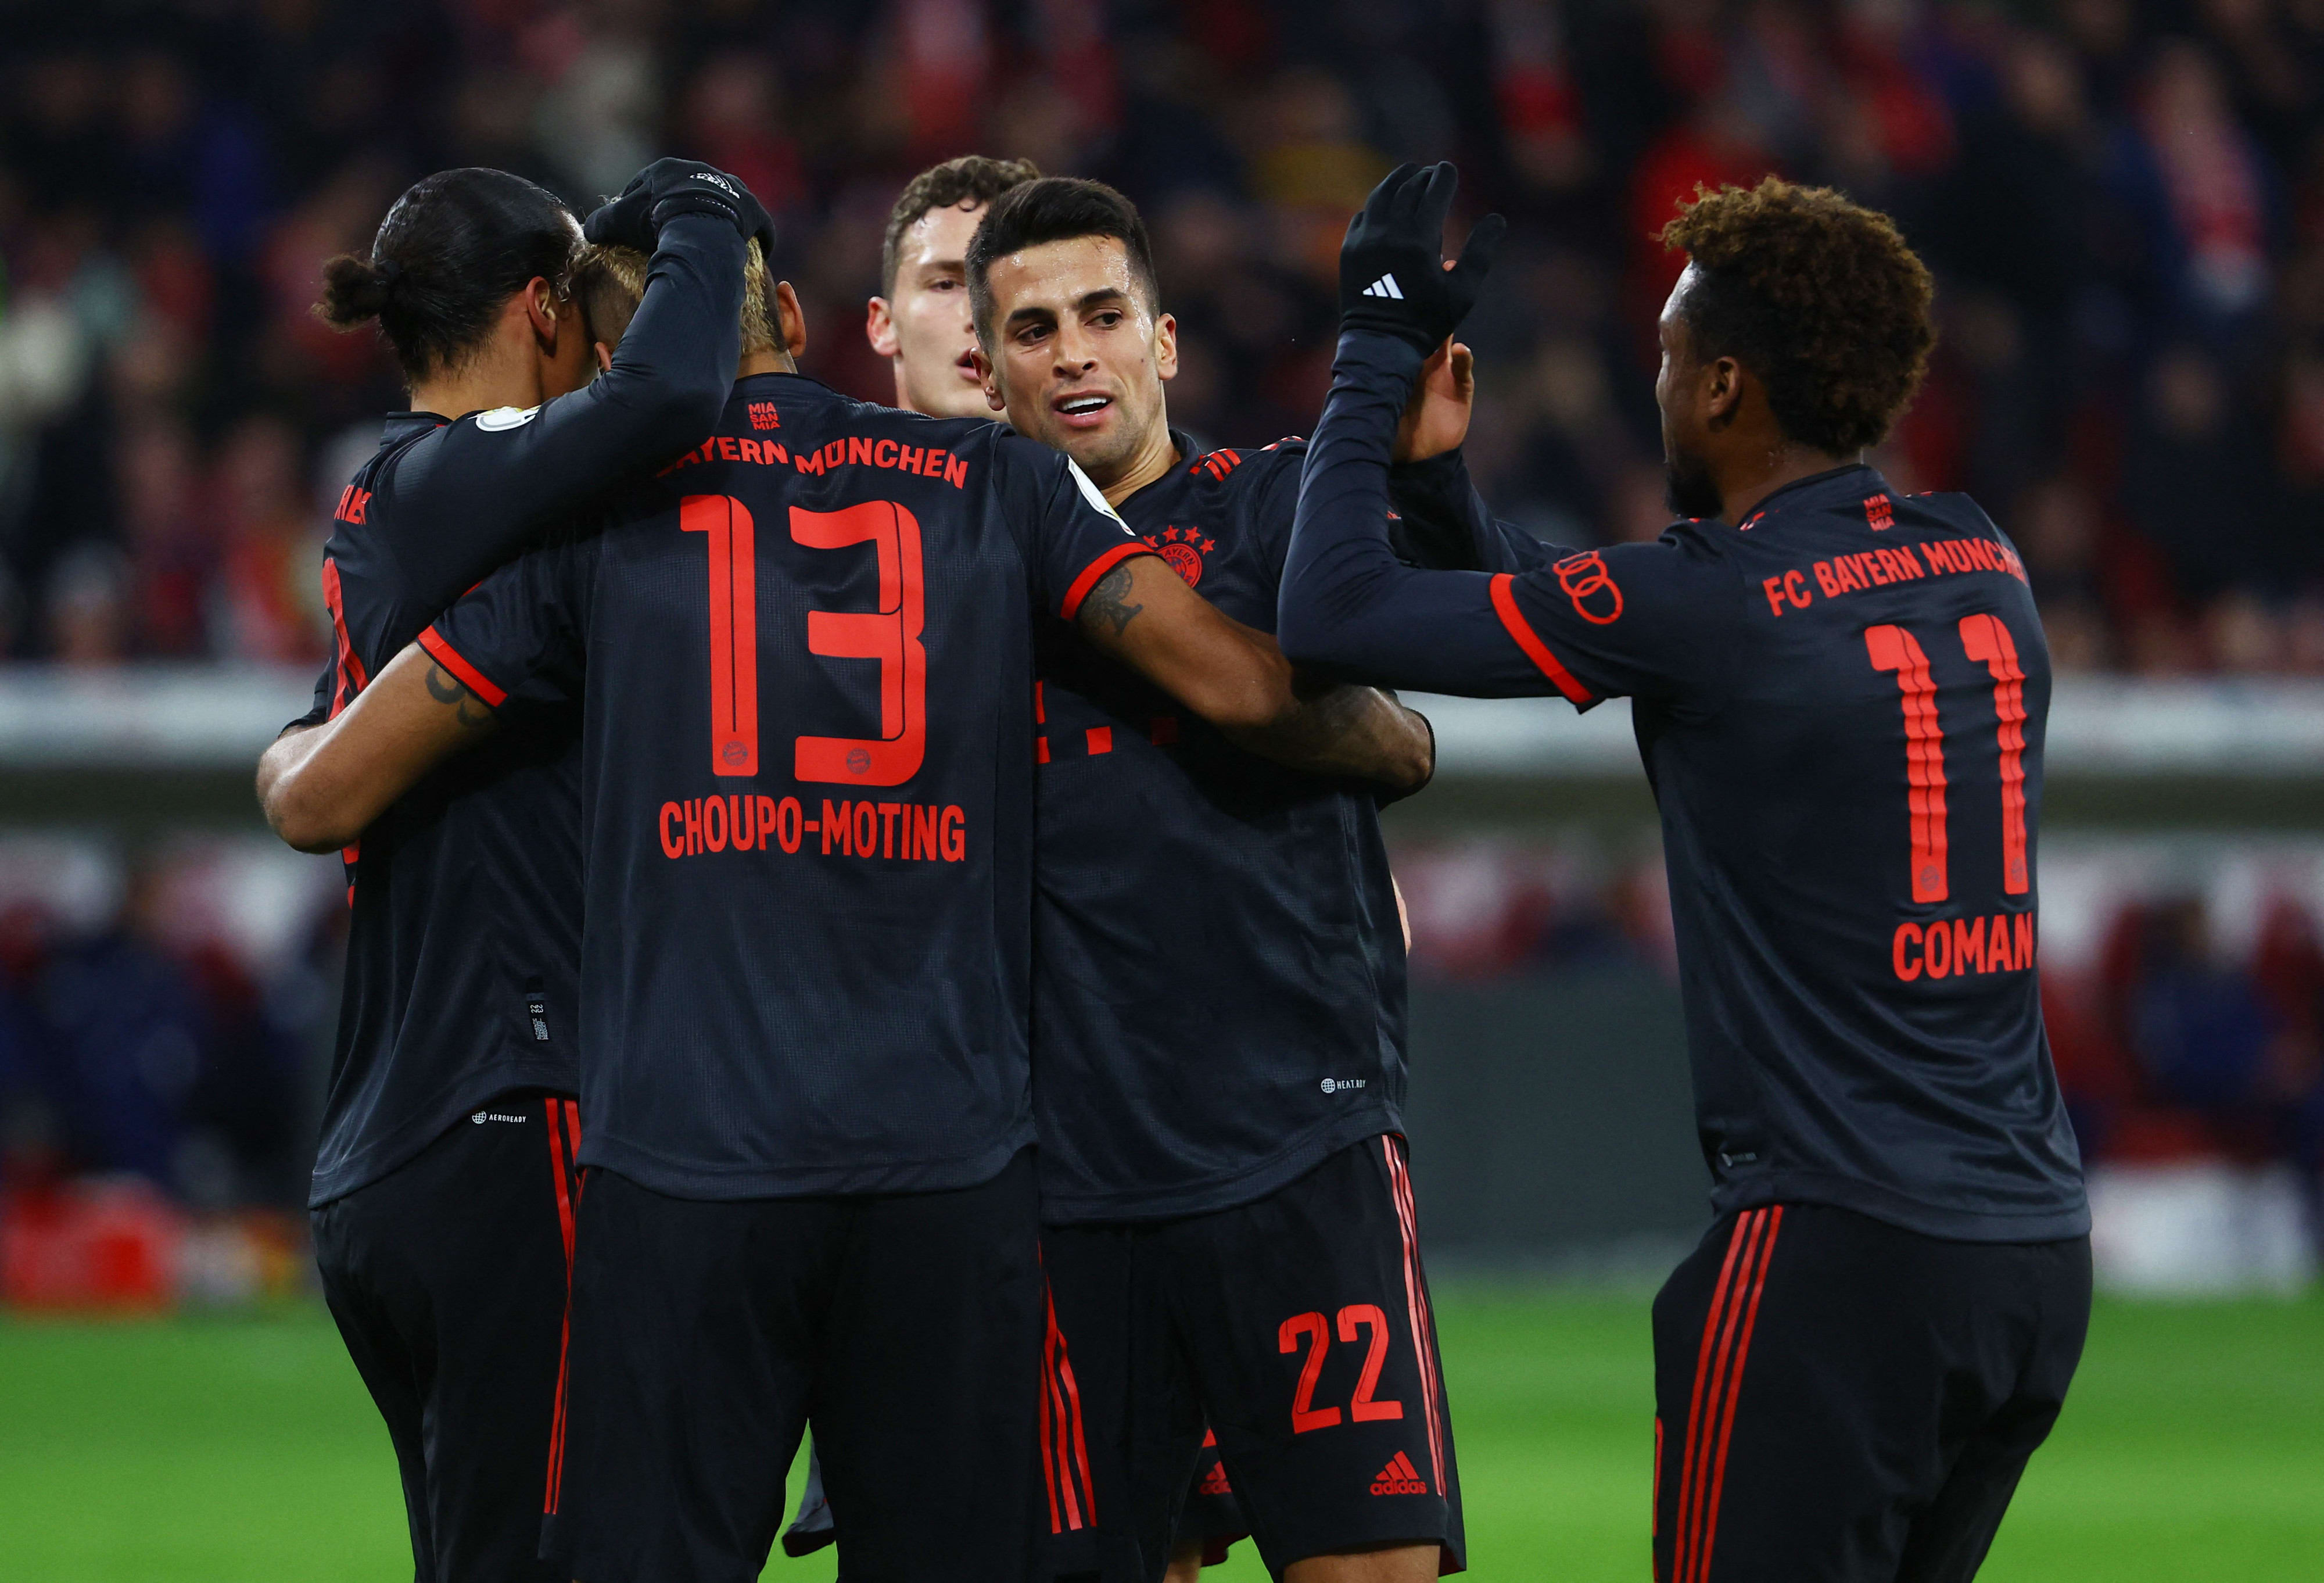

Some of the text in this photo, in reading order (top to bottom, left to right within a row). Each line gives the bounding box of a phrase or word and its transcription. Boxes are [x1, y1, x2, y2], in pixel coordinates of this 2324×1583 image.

[748, 402, 777, 414] MIA
[749, 413, 780, 422] SAN
[753, 421, 781, 431] MIA
[655, 436, 969, 489] AYERN MÜNCHEN
[1163, 547, 1196, 565] AYERN
[1762, 569, 1812, 617] FC
[1812, 543, 1926, 599] BAYERN
[680, 494, 927, 787] 13
[1864, 613, 2029, 904] 11
[659, 794, 966, 862] CHOUPO-MOTING
[1892, 912, 2033, 982] COMAN
[1337, 1079, 1366, 1090] HEAT.RDY
[489, 1114, 526, 1123] AEROREADY
[1278, 1303, 1404, 1435] 22
[1369, 1481, 1428, 1496] adidas
